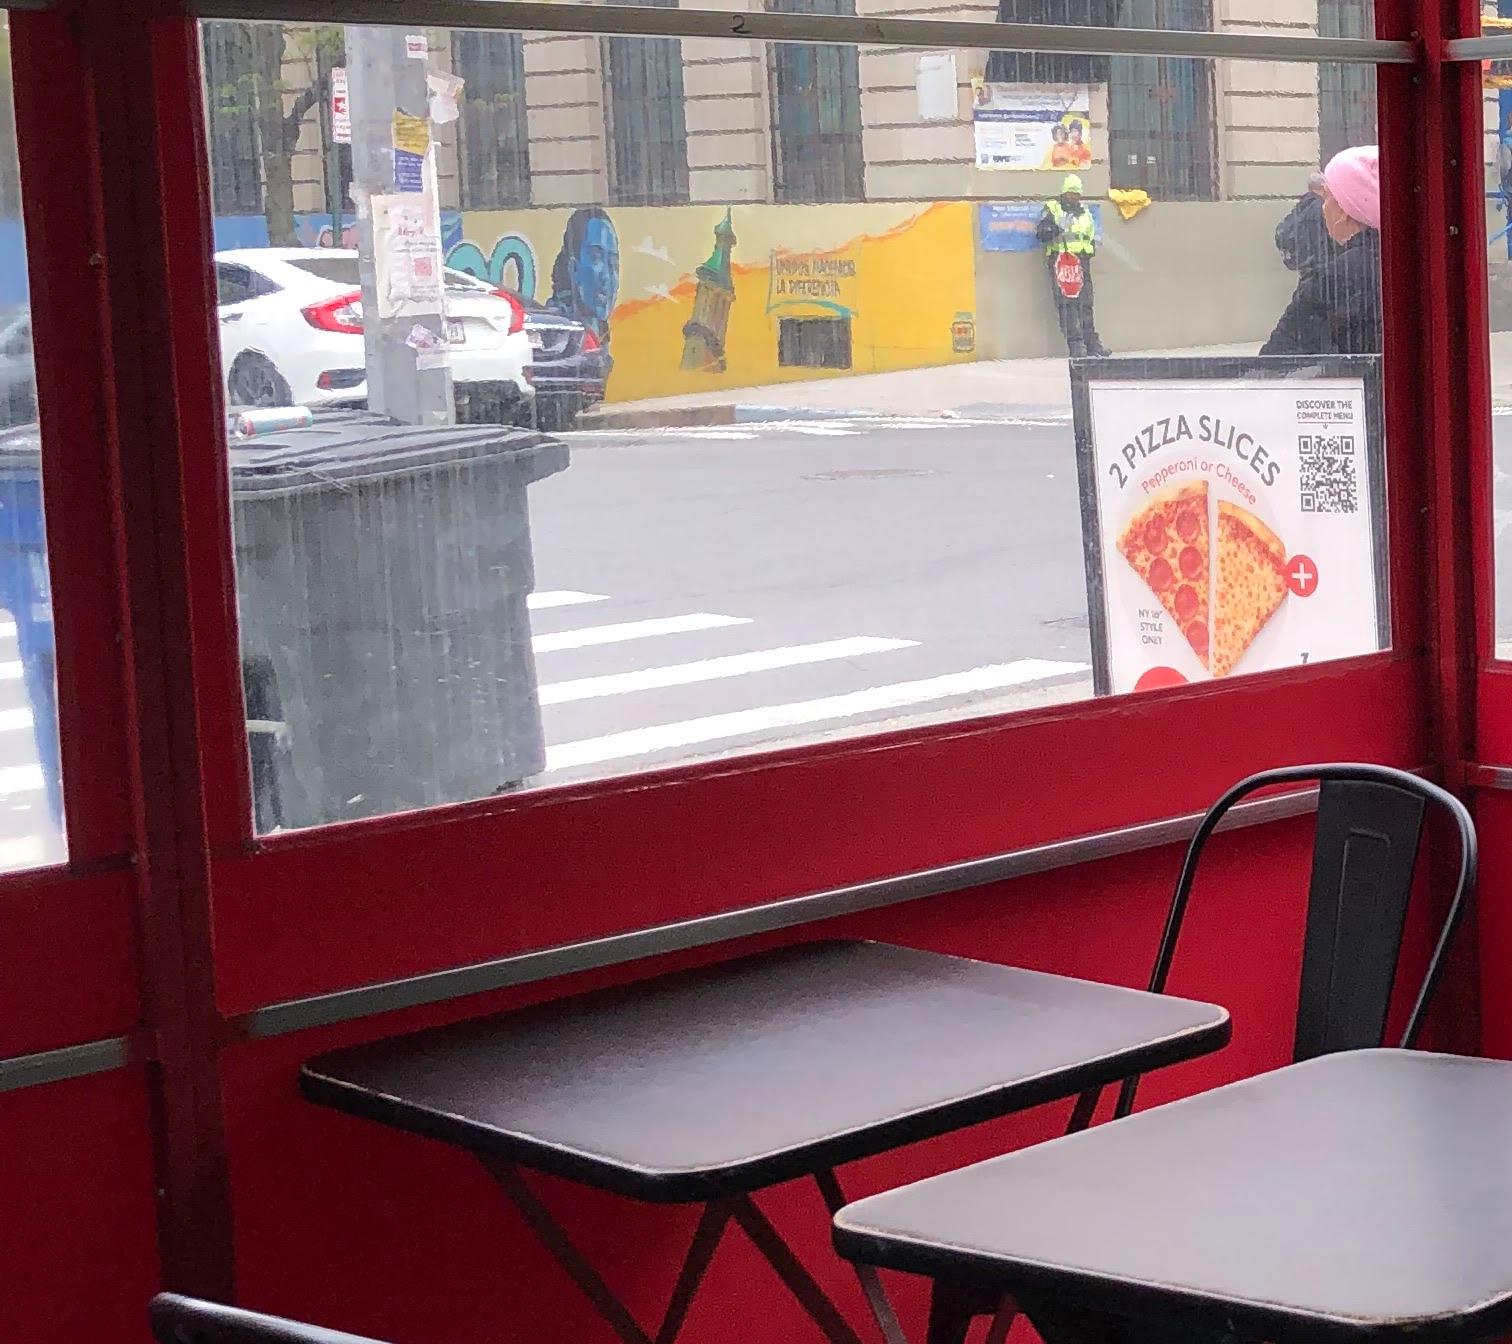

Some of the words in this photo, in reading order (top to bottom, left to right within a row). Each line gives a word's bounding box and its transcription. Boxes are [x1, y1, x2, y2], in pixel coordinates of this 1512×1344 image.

[1296, 400, 1335, 409] DISCOVER
[1336, 400, 1352, 409] THE
[1108, 462, 1129, 488] 2
[1121, 414, 1193, 470] PIZZA
[1198, 414, 1281, 487] SLICES
[1141, 456, 1198, 495] Pepperoni
[1200, 460, 1214, 473] or
[1216, 463, 1256, 505] Cheese
[1138, 609, 1149, 618] NY
[1140, 622, 1163, 632] STYLE
[1141, 635, 1162, 645] ONLY
